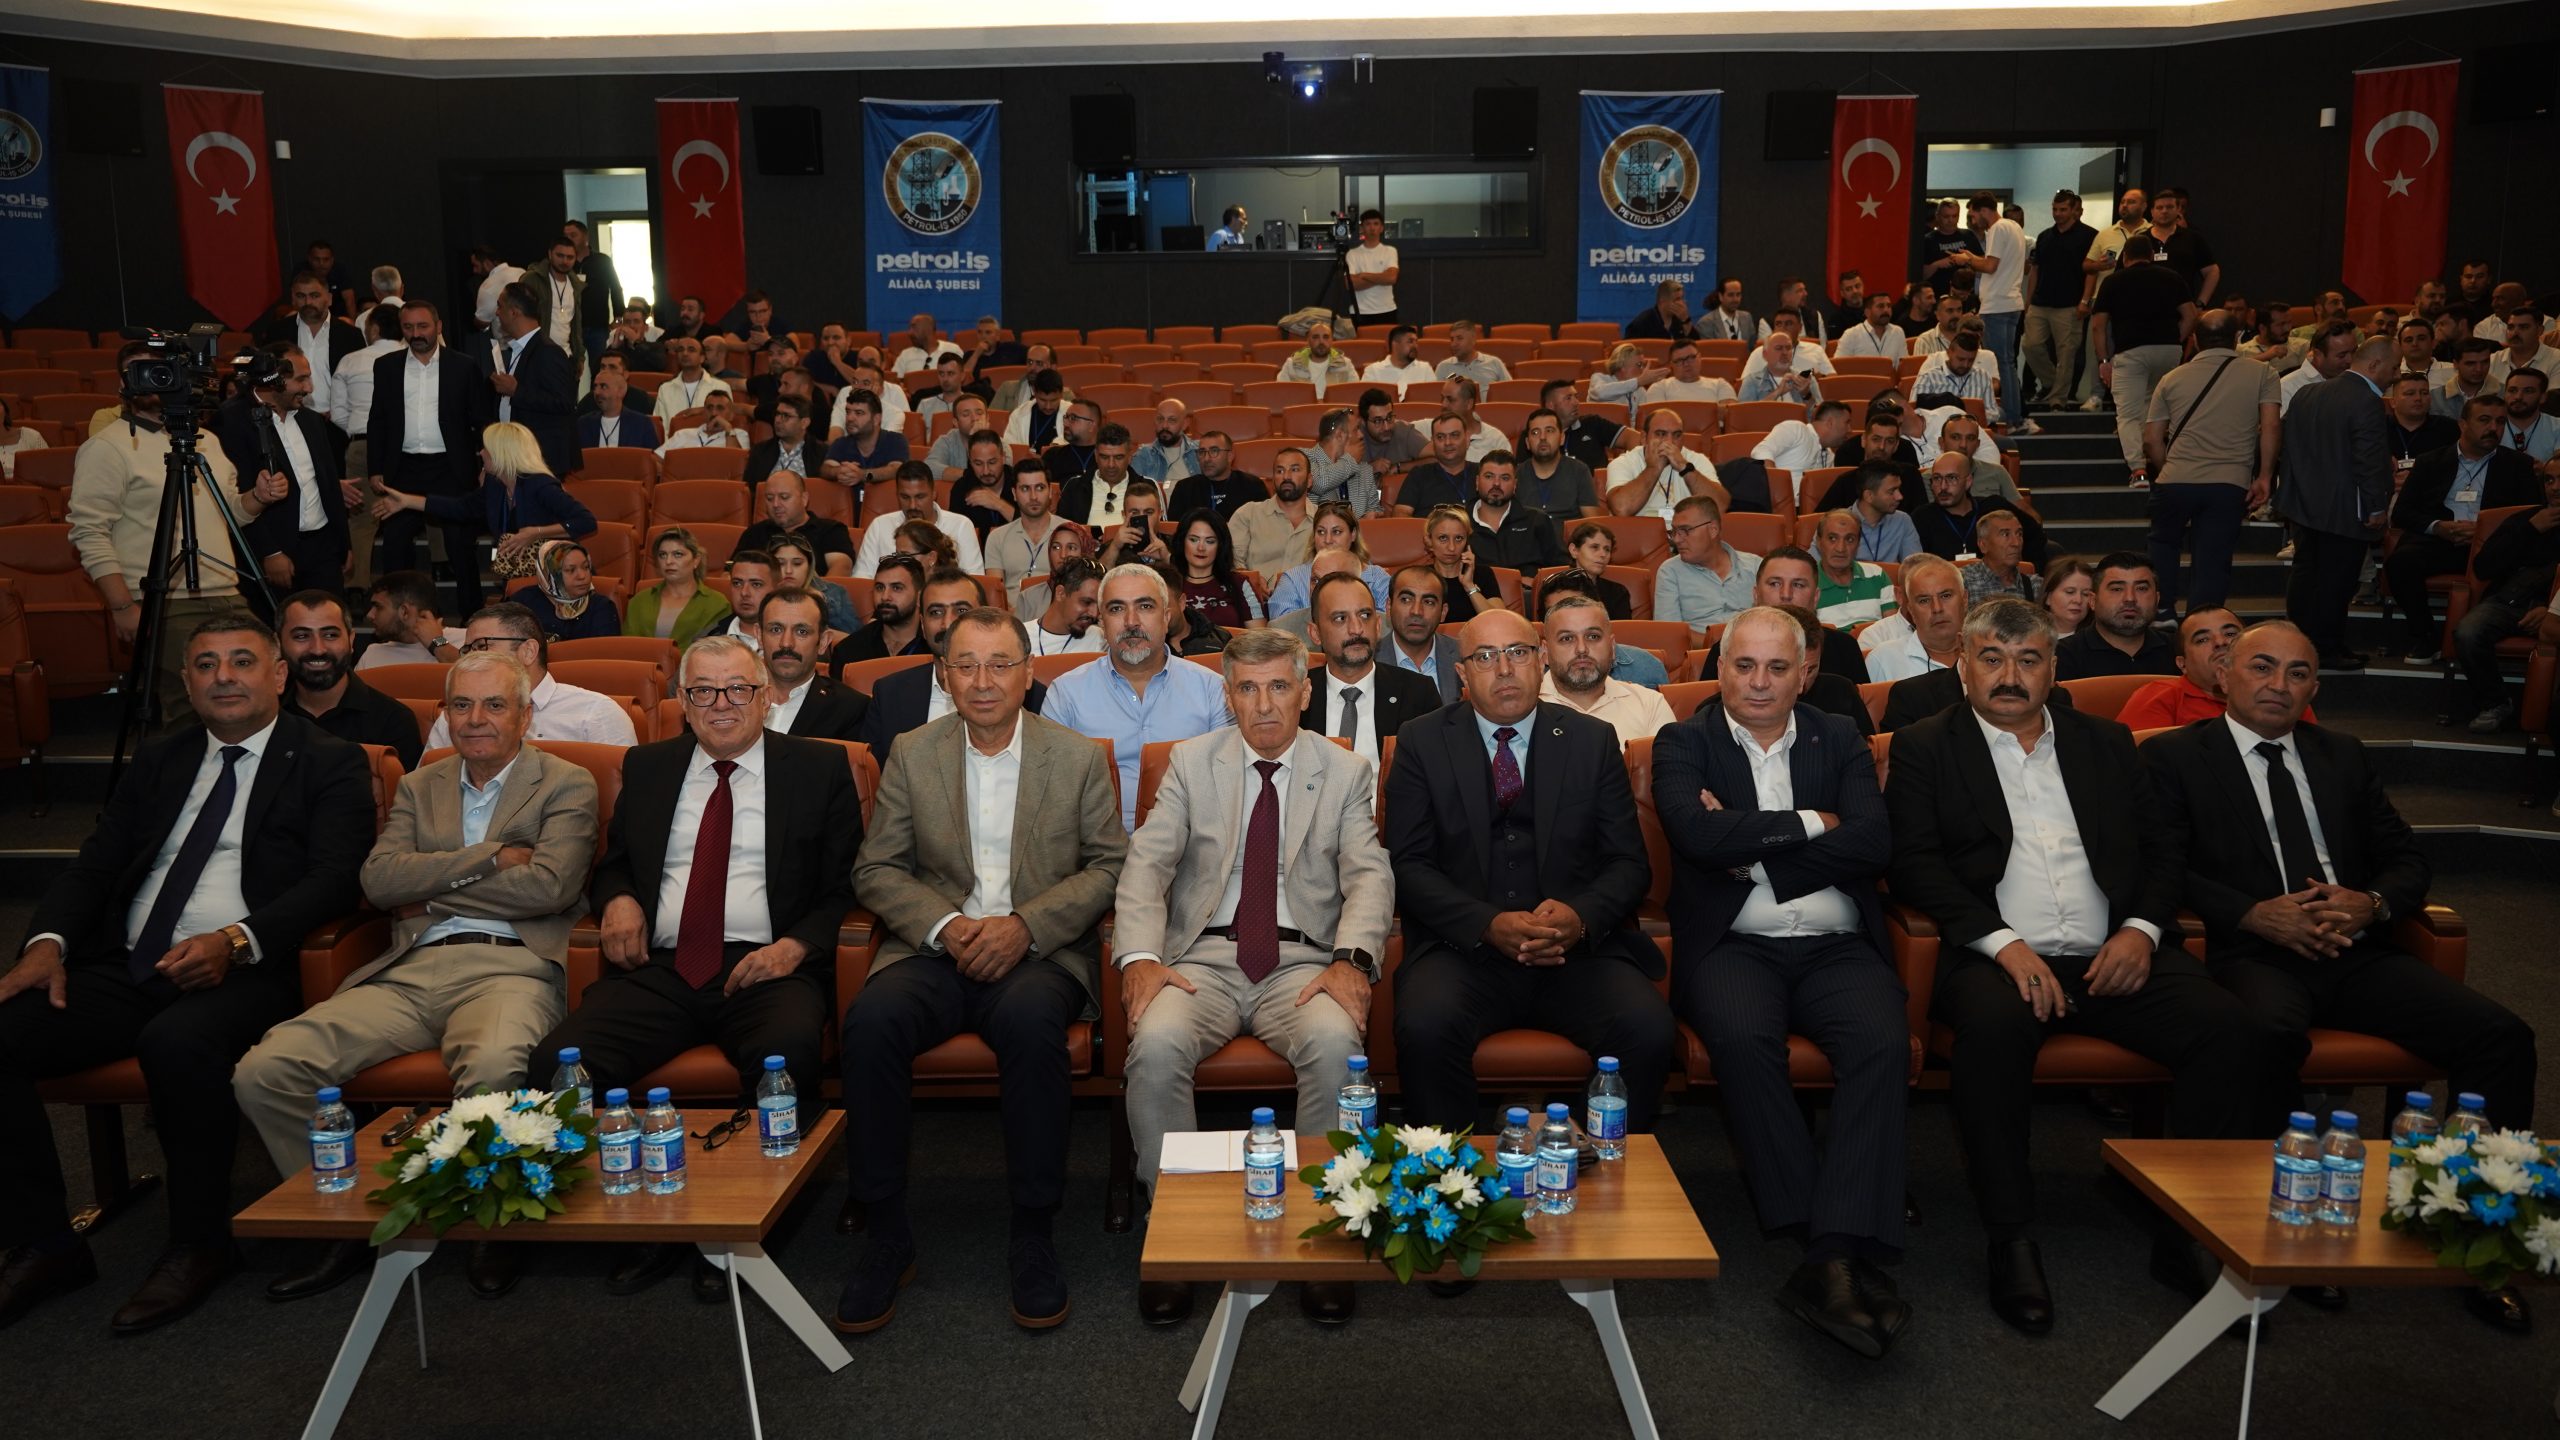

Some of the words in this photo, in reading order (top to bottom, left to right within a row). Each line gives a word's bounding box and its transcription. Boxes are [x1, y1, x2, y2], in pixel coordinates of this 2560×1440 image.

[1618, 206, 1665, 225] PETROL-İŞ
[1666, 201, 1684, 218] 1950
[1600, 271, 1645, 283] ALİAĞA
[888, 277, 933, 289] ALİAĞA
[935, 277, 981, 292] ŞUBESİ
[771, 1109, 794, 1118] SİRAB
[1540, 1160, 1566, 1169] SİRAB
